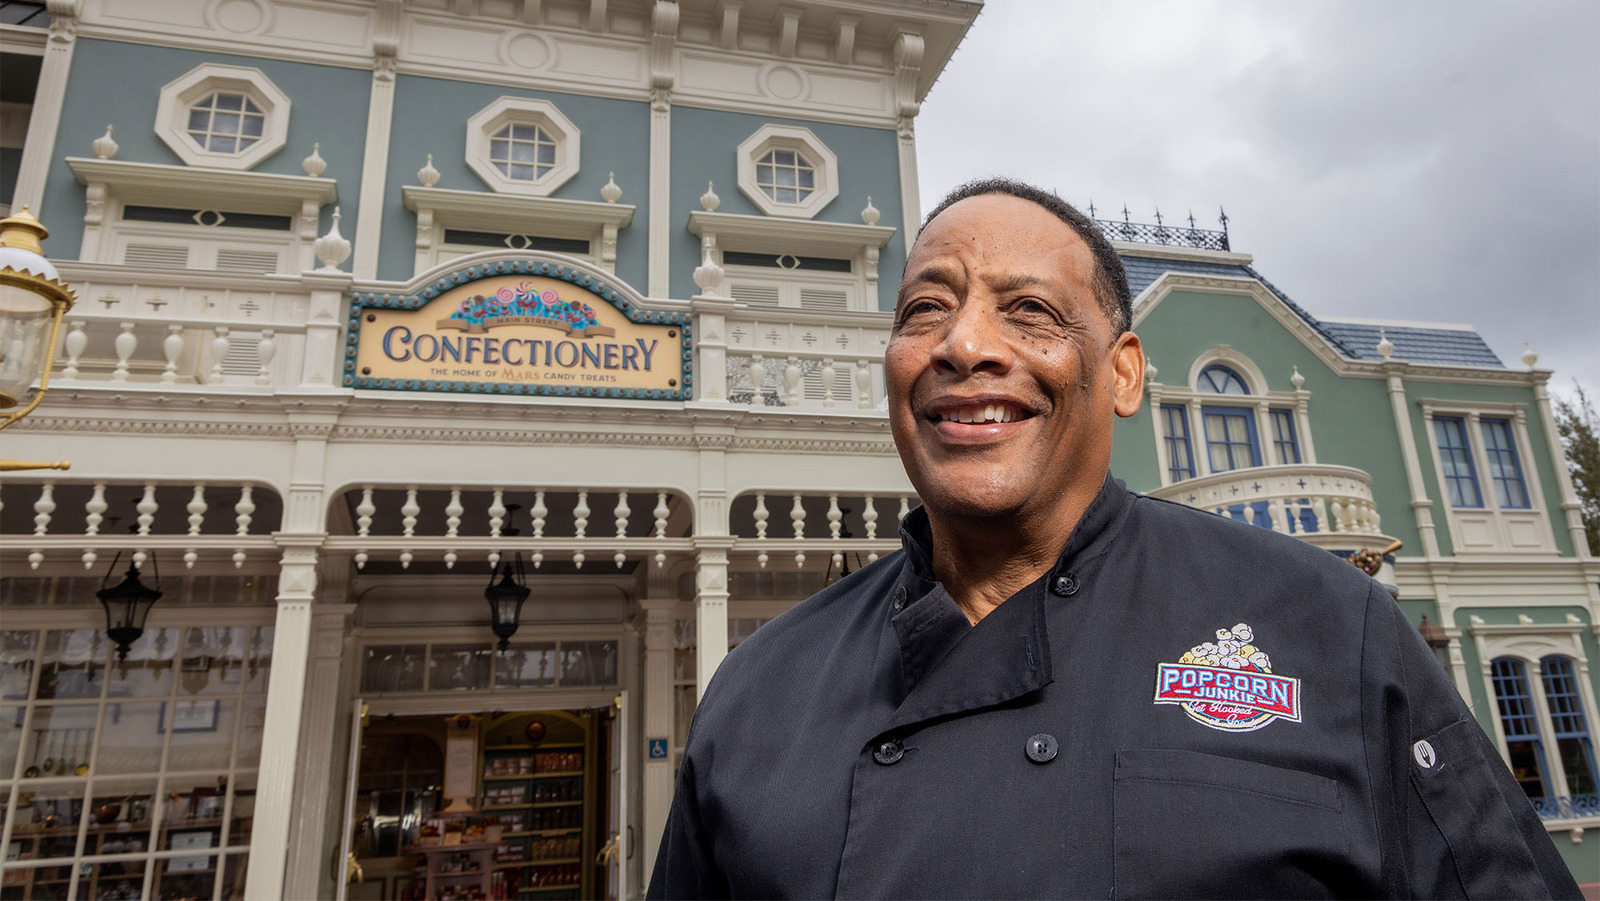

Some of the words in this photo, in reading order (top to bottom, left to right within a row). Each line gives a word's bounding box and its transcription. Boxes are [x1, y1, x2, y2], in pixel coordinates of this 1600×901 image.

[524, 317, 559, 326] STREET
[382, 325, 659, 372] CONFECTIONERY
[430, 368, 448, 376] THE
[452, 369, 481, 377] HOME
[485, 370, 498, 378] OF
[501, 367, 540, 381] MARS
[544, 372, 576, 381] CANDY
[581, 374, 617, 382] TREATS
[1160, 668, 1291, 709] POPCORN
[1193, 686, 1257, 704] JUNKIE
[1189, 700, 1207, 712] Get
[1209, 701, 1253, 715] Hooked
